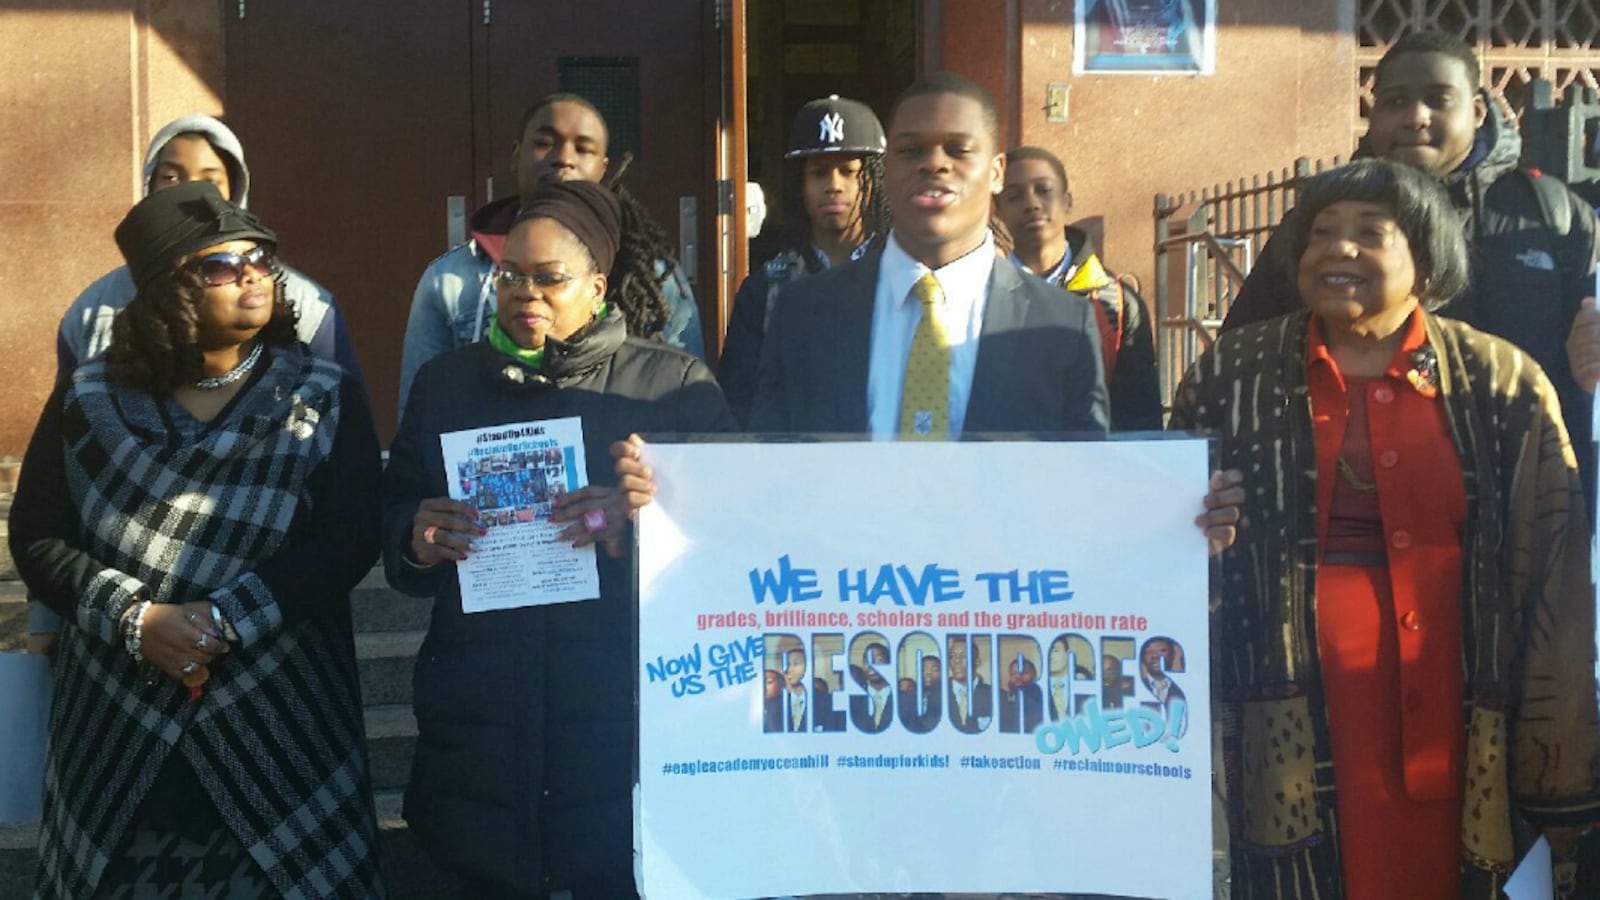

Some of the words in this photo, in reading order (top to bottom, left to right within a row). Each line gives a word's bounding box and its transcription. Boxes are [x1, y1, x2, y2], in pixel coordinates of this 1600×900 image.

[819, 112, 844, 143] NY
[748, 554, 823, 605] WE
[838, 563, 966, 606] HAVE
[975, 568, 1074, 605] THE
[697, 610, 761, 630] grades,
[765, 609, 852, 628] brilliance,
[857, 610, 932, 628] scholars
[937, 611, 969, 628] and
[974, 611, 1001, 628] the
[1007, 611, 1106, 630] graduation
[1111, 613, 1148, 631] rate
[645, 643, 701, 683] NOW
[708, 635, 767, 668] GIVE
[671, 674, 705, 698] US
[709, 661, 757, 689] THE
[762, 630, 1189, 740] RESOURCES
[1035, 697, 1185, 755] OWED!
[662, 753, 829, 776] #eagleacademyoceanhill
[960, 755, 1041, 771] #takeaction
[1053, 758, 1192, 779] #reclaimourschools
